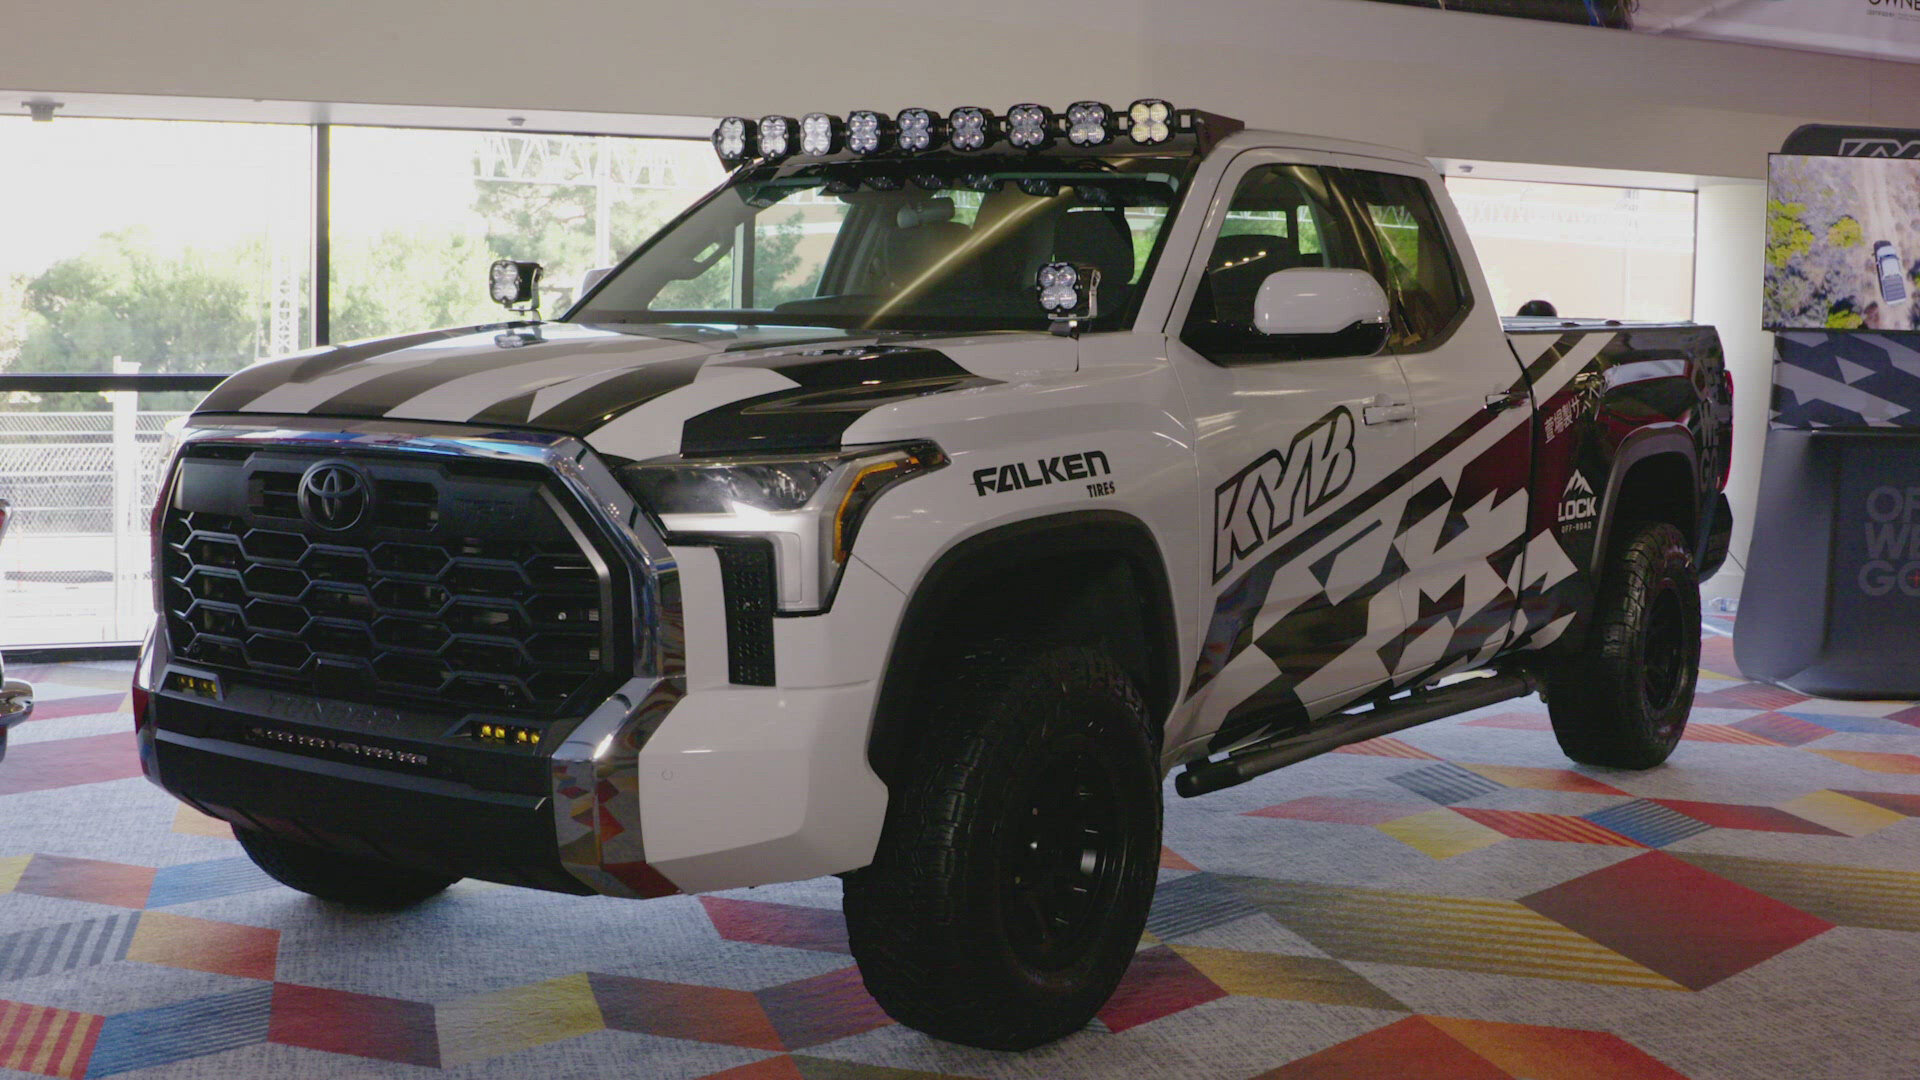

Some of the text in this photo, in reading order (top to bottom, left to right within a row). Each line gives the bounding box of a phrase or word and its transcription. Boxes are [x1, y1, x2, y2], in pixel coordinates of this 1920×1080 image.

[972, 450, 1111, 496] FALKEN
[1086, 481, 1115, 498] TIRES
[1212, 405, 1356, 586] KYB
[1558, 496, 1597, 522] LOCK
[1561, 521, 1592, 534] OFF-ROAD
